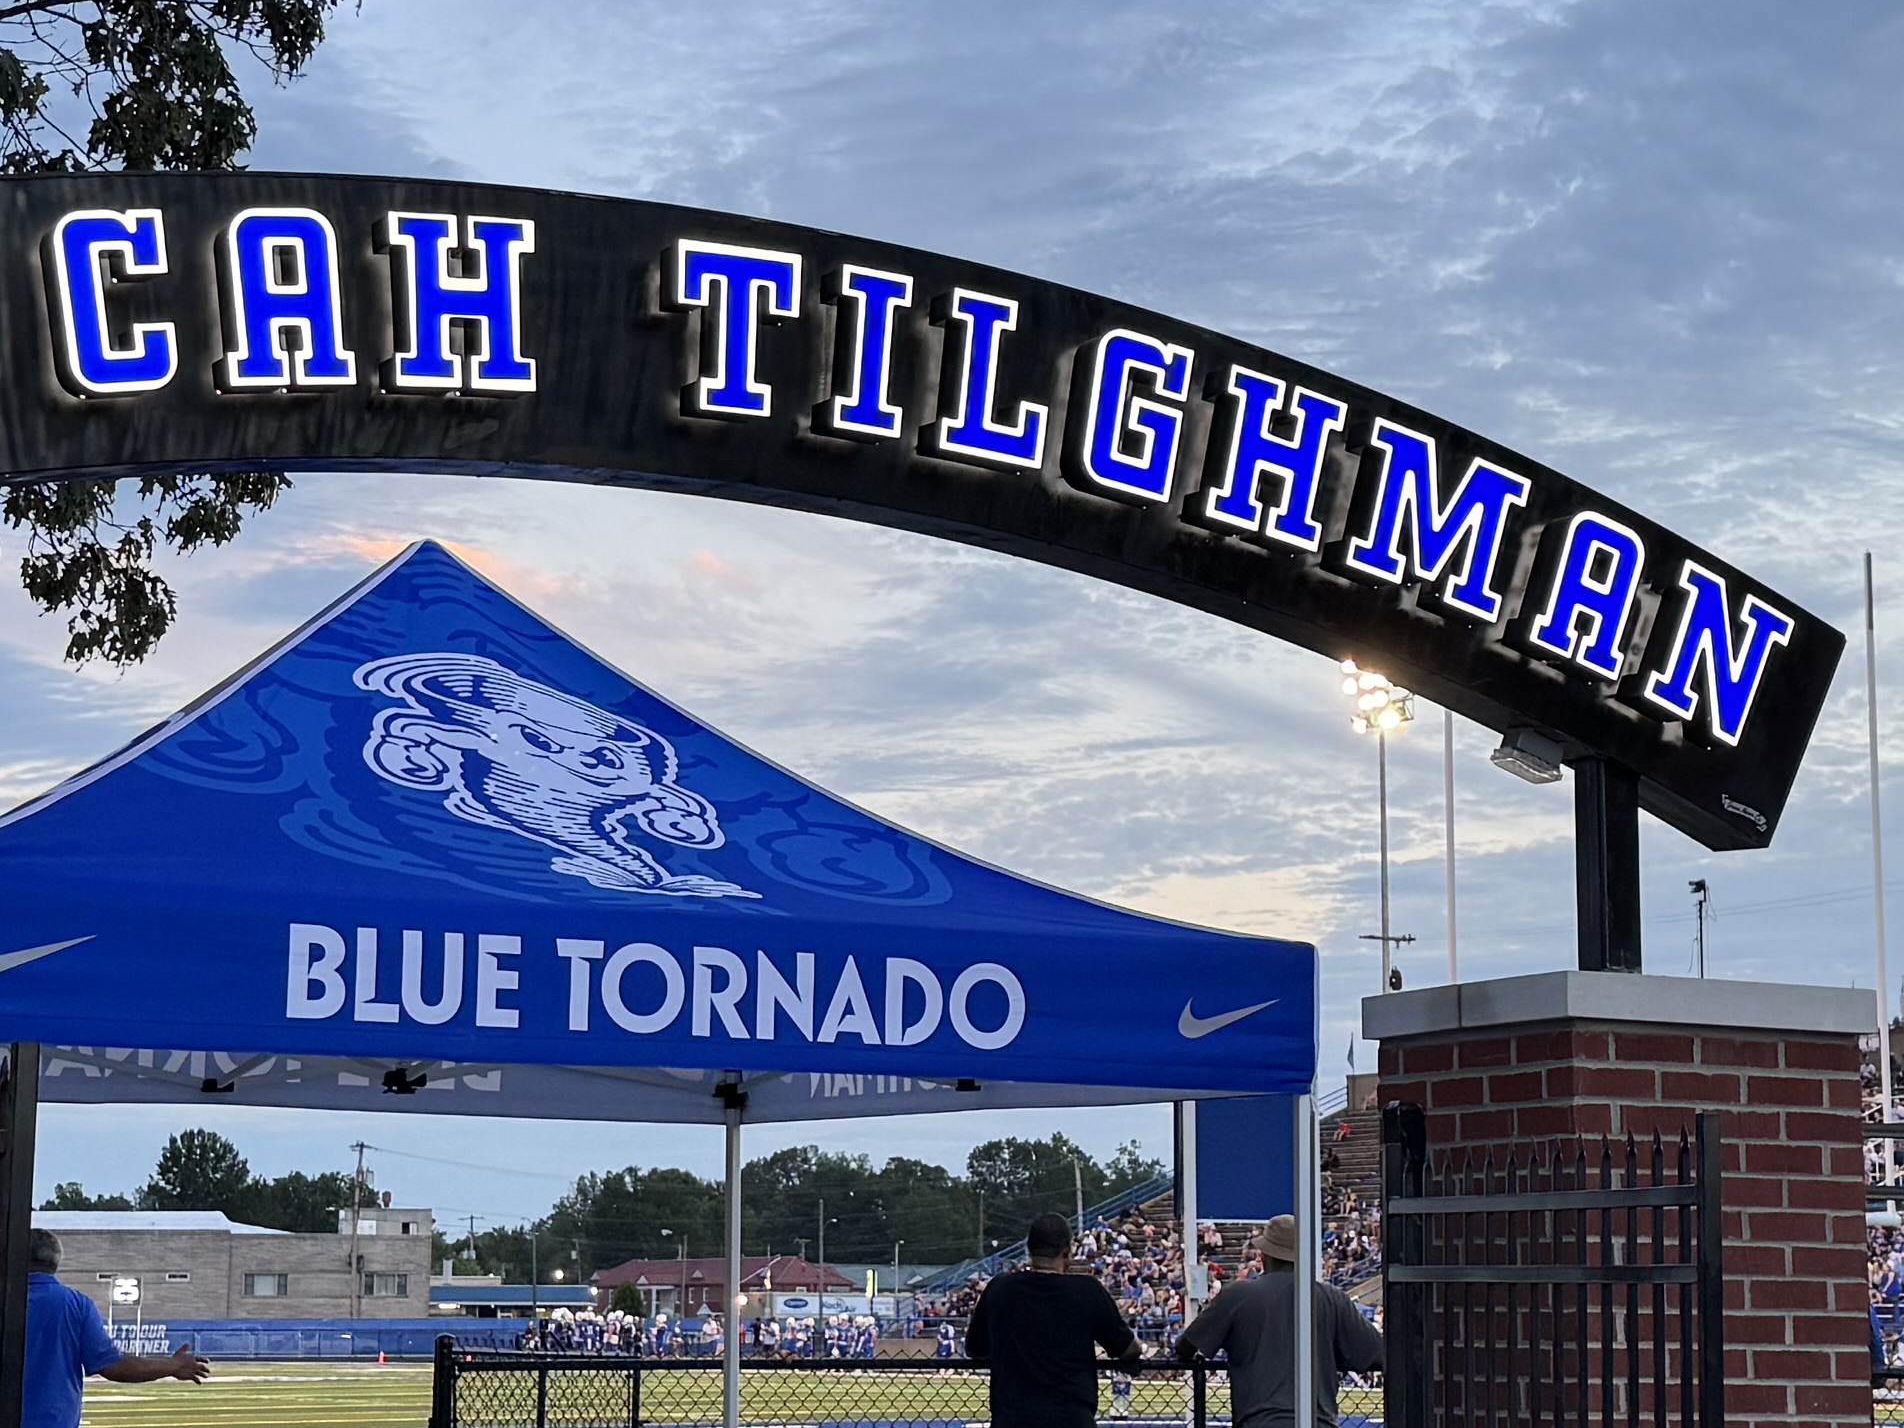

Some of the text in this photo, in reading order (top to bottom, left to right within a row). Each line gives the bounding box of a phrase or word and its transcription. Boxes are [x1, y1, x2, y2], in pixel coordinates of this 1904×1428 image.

[677, 239, 1792, 747] TILGHMAN
[286, 923, 1026, 1051] BLUE TORNADO
[140, 1324, 166, 1339] OUR
